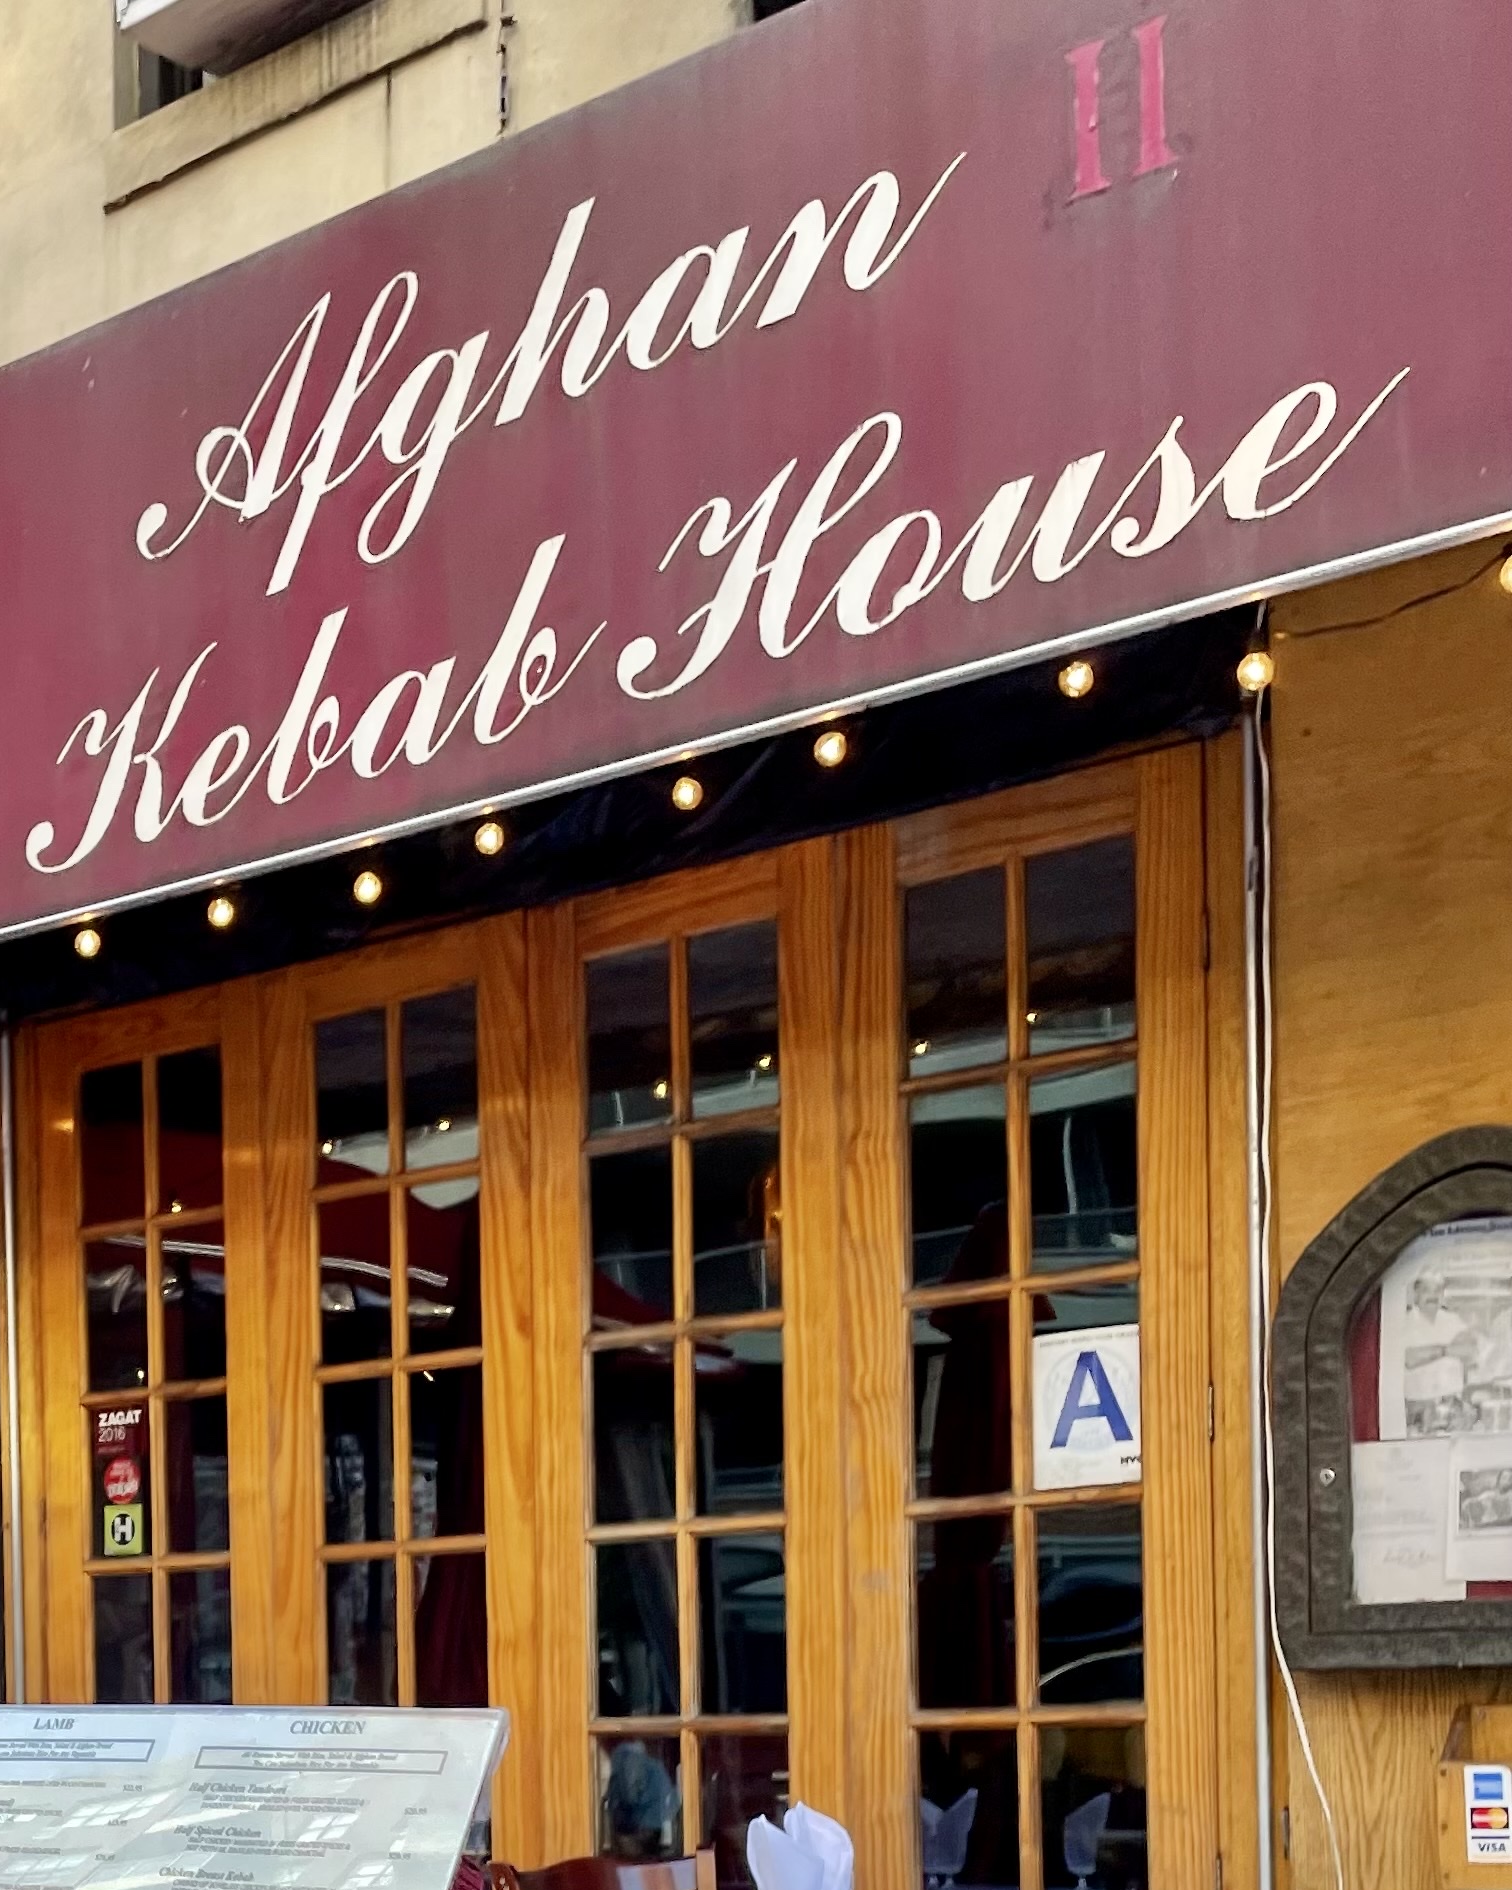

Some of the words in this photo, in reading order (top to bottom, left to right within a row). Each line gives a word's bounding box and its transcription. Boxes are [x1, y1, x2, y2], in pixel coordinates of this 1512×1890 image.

[136, 151, 967, 595] Afghan
[25, 533, 607, 874] Kebab
[615, 367, 1411, 700] House
[1050, 1350, 1134, 1448] A
[98, 1410, 142, 1427] ZAGAT
[34, 1718, 75, 1730] LAMB
[290, 1721, 366, 1735] CHICKEN
[1478, 1843, 1506, 1852] VISA
